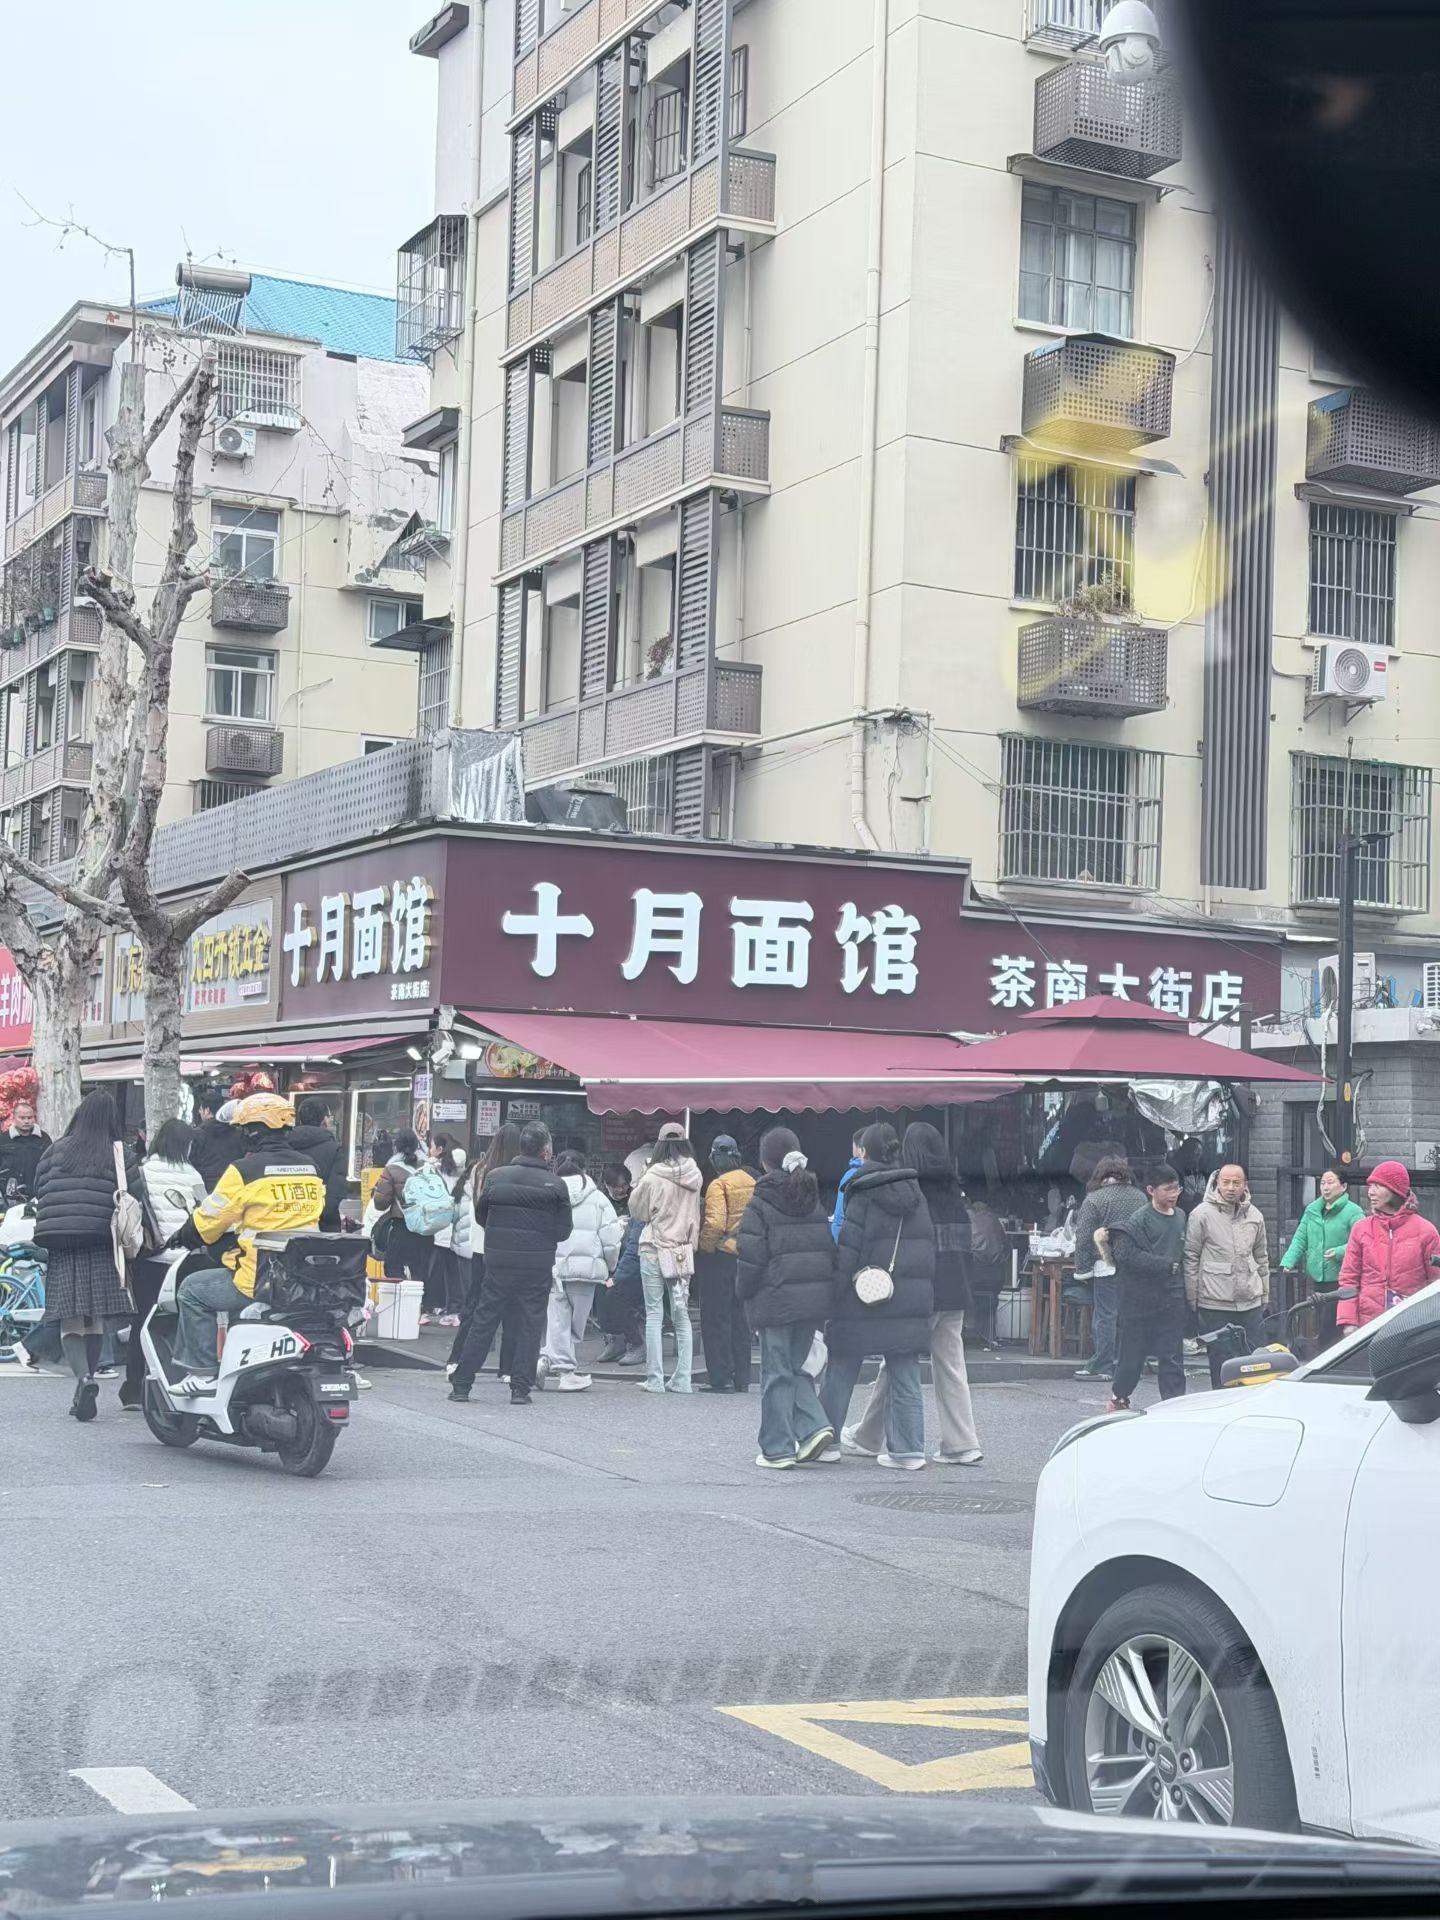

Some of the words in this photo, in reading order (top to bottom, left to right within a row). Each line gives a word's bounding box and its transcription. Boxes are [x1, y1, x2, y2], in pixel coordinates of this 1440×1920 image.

[283, 876, 435, 987] 十月面馆
[502, 882, 920, 995] 十月面馆
[990, 955, 1243, 1022] 茶南大街店
[270, 1183, 317, 1200] 订酒店
